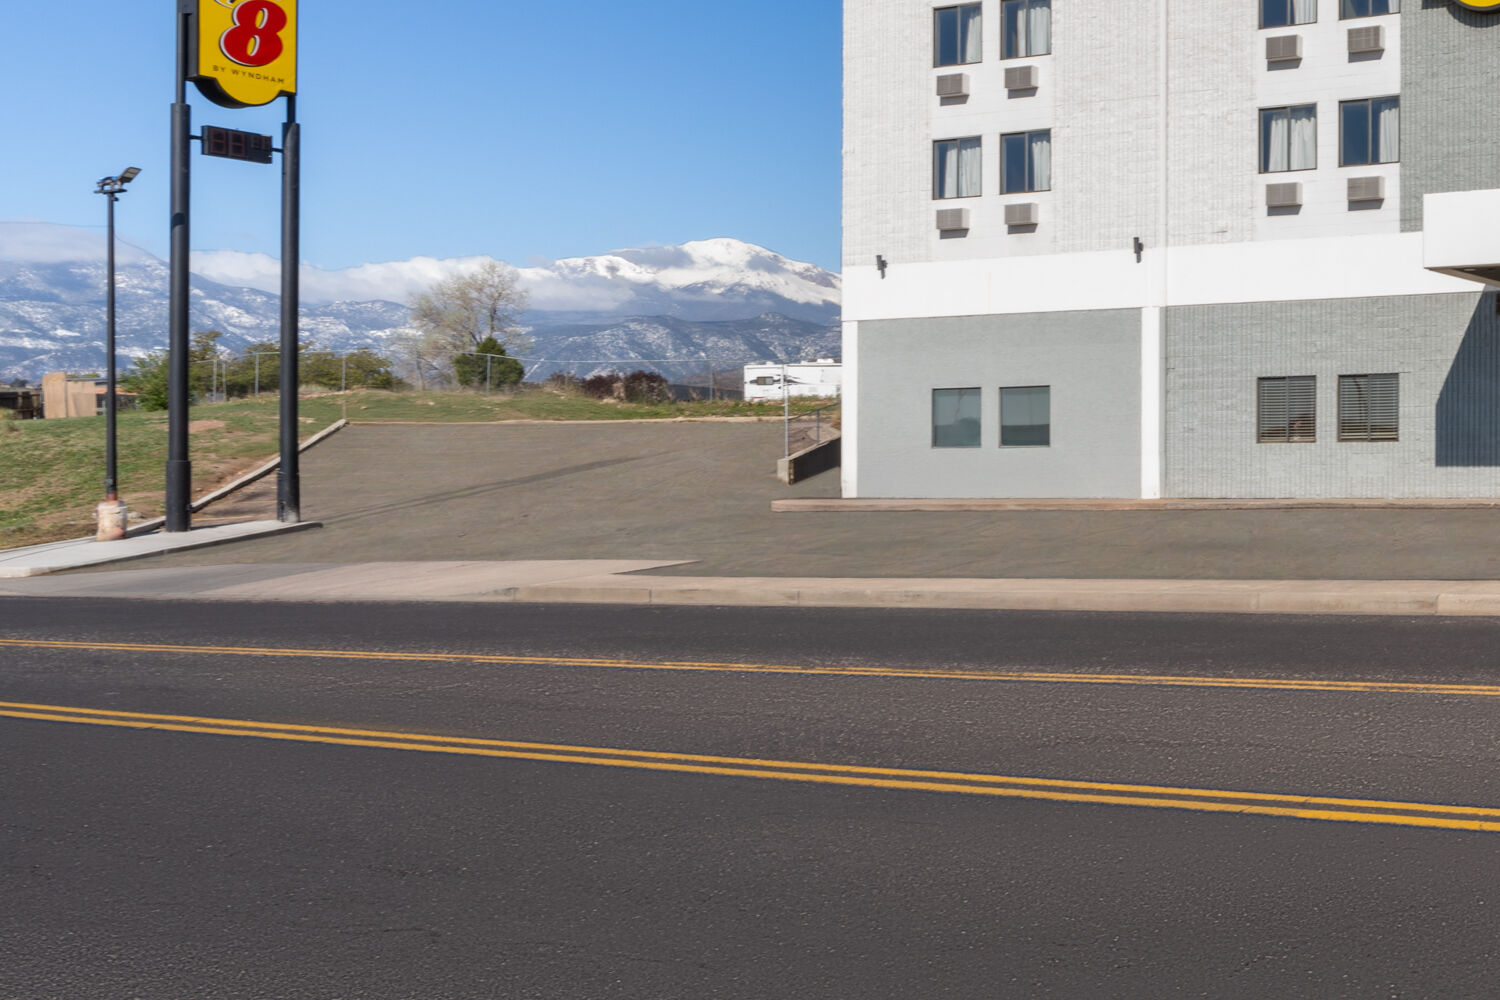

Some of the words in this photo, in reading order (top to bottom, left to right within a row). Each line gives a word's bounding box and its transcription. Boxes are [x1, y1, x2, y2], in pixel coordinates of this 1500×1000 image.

[219, 0, 288, 67] 8
[212, 64, 226, 73] BY
[231, 69, 285, 85] WYNDHAM
